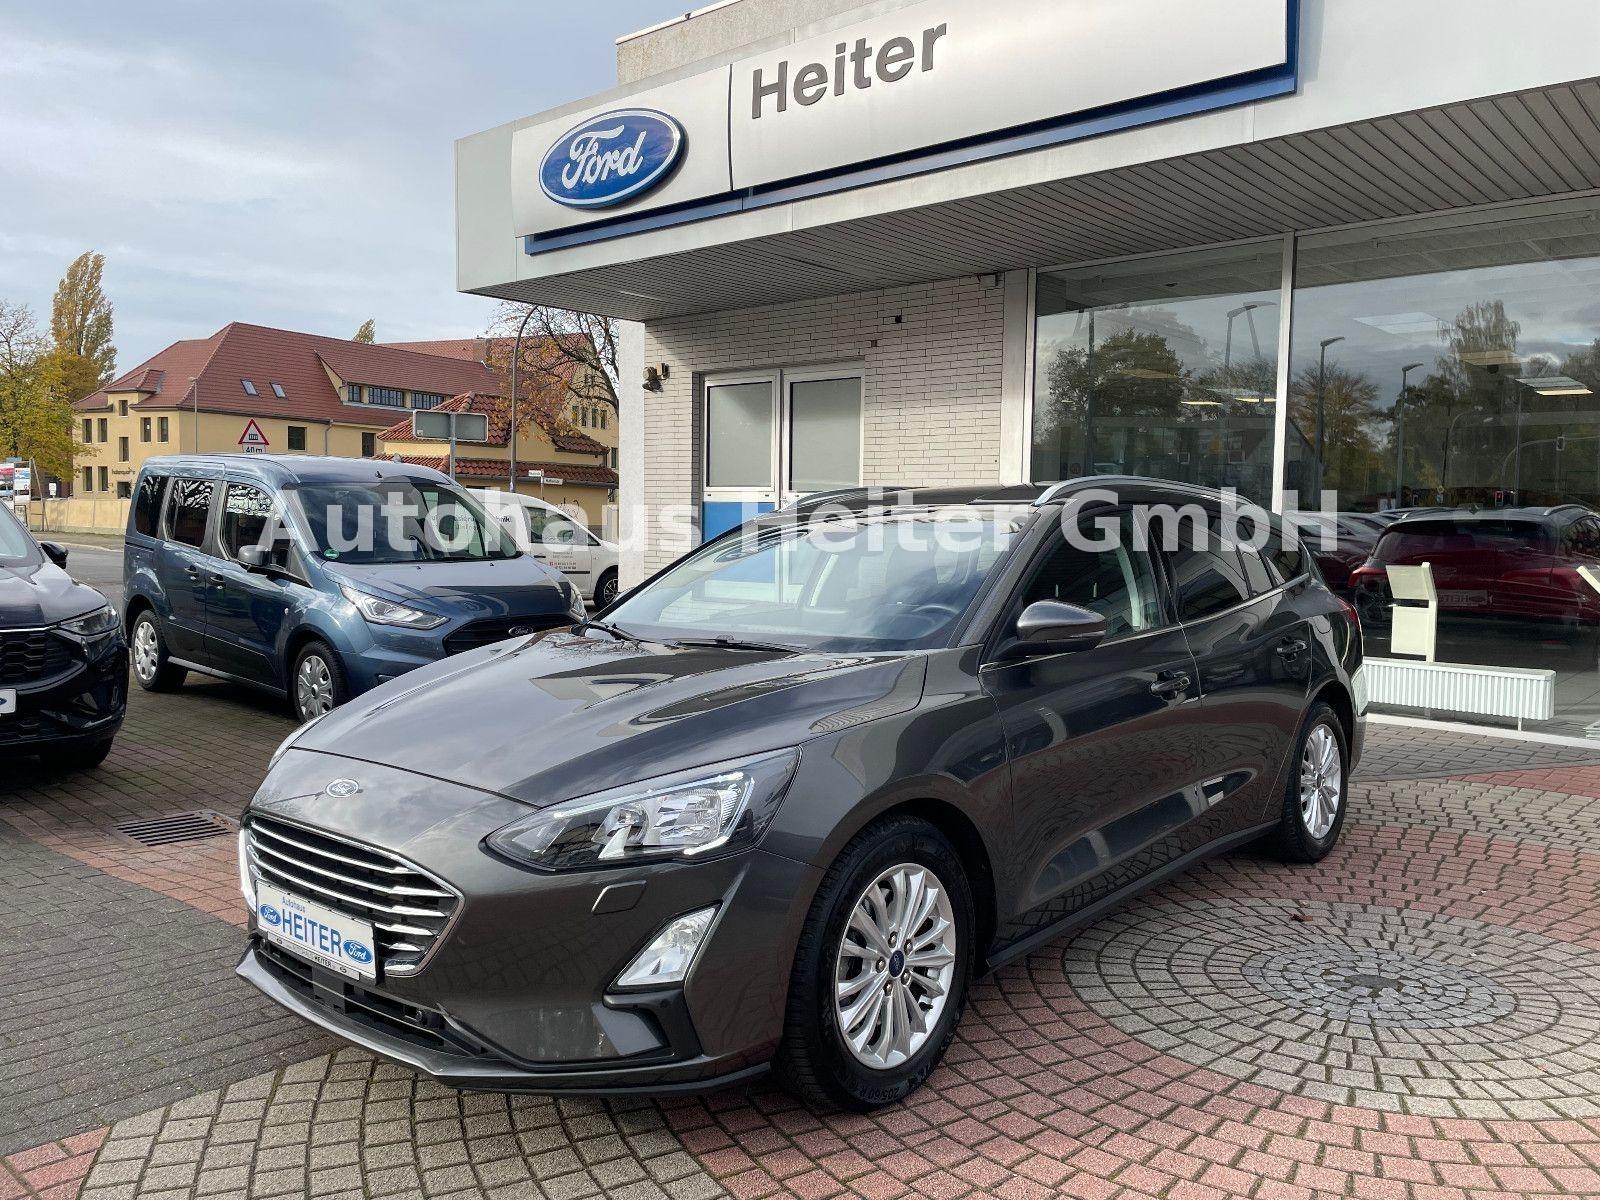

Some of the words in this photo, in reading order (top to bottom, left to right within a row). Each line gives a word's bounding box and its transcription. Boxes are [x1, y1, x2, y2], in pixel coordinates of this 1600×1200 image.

[751, 22, 947, 119] Heiter
[562, 124, 647, 189] Ford
[282, 908, 342, 957] HEITER
